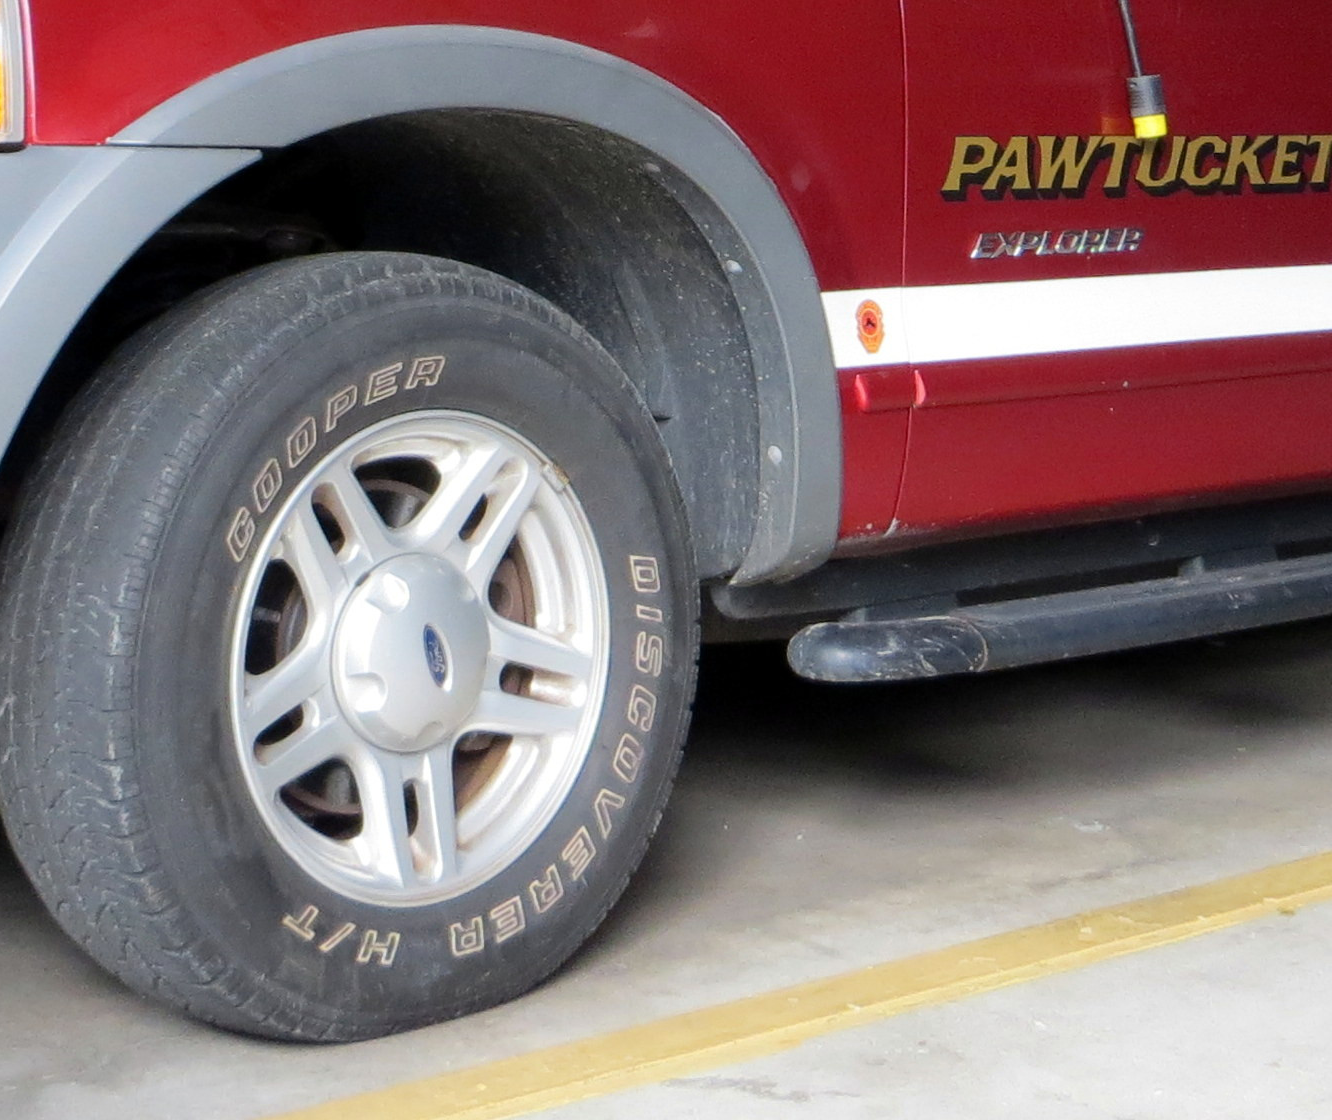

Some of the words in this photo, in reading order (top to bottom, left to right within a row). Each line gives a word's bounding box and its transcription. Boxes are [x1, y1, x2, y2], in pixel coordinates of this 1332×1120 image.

[970, 227, 1145, 260] EXPLORER
[227, 355, 446, 563] COOPER
[449, 554, 663, 957] DISCOVERER
[281, 905, 401, 967] H/T
